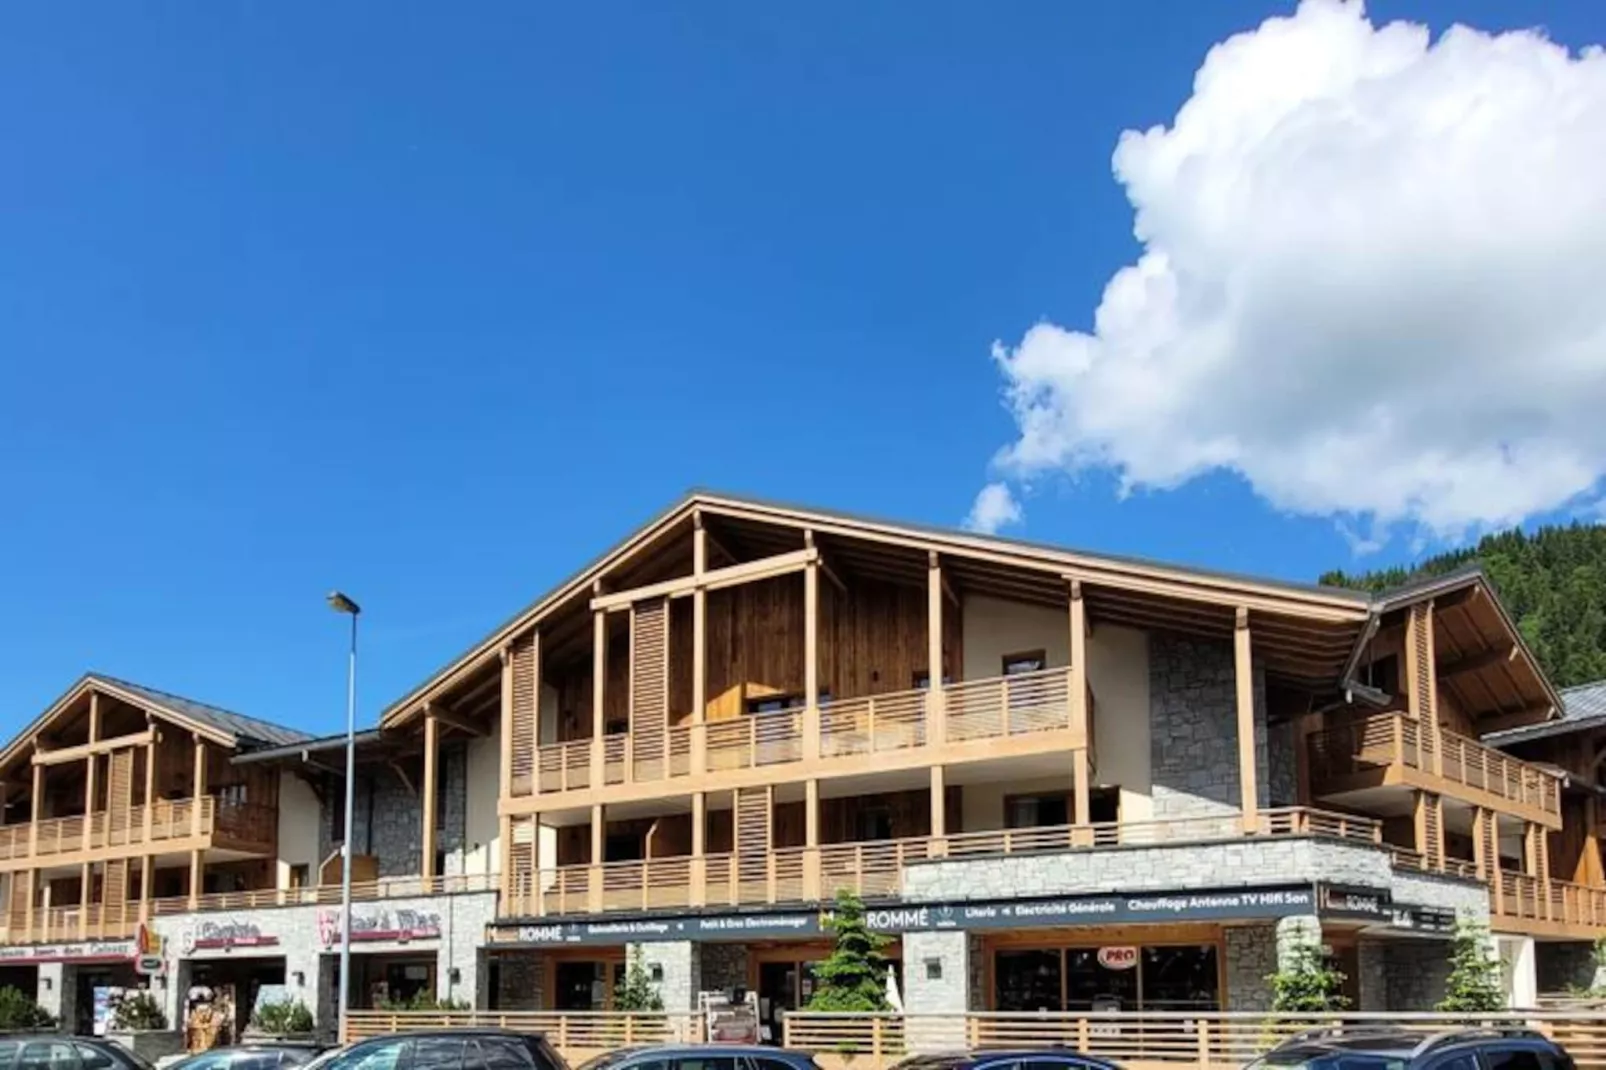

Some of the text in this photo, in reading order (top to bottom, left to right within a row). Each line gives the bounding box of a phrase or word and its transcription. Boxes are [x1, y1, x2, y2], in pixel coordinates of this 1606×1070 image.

[964, 906, 997, 918] Literie
[1068, 901, 1116, 914] Générale
[1127, 896, 1187, 911] Chauffage
[1189, 896, 1239, 908] Antenne
[1241, 893, 1257, 905] TV
[1285, 892, 1308, 904] Son
[866, 907, 929, 929] ROMMÉ
[1106, 949, 1135, 962] PRO
